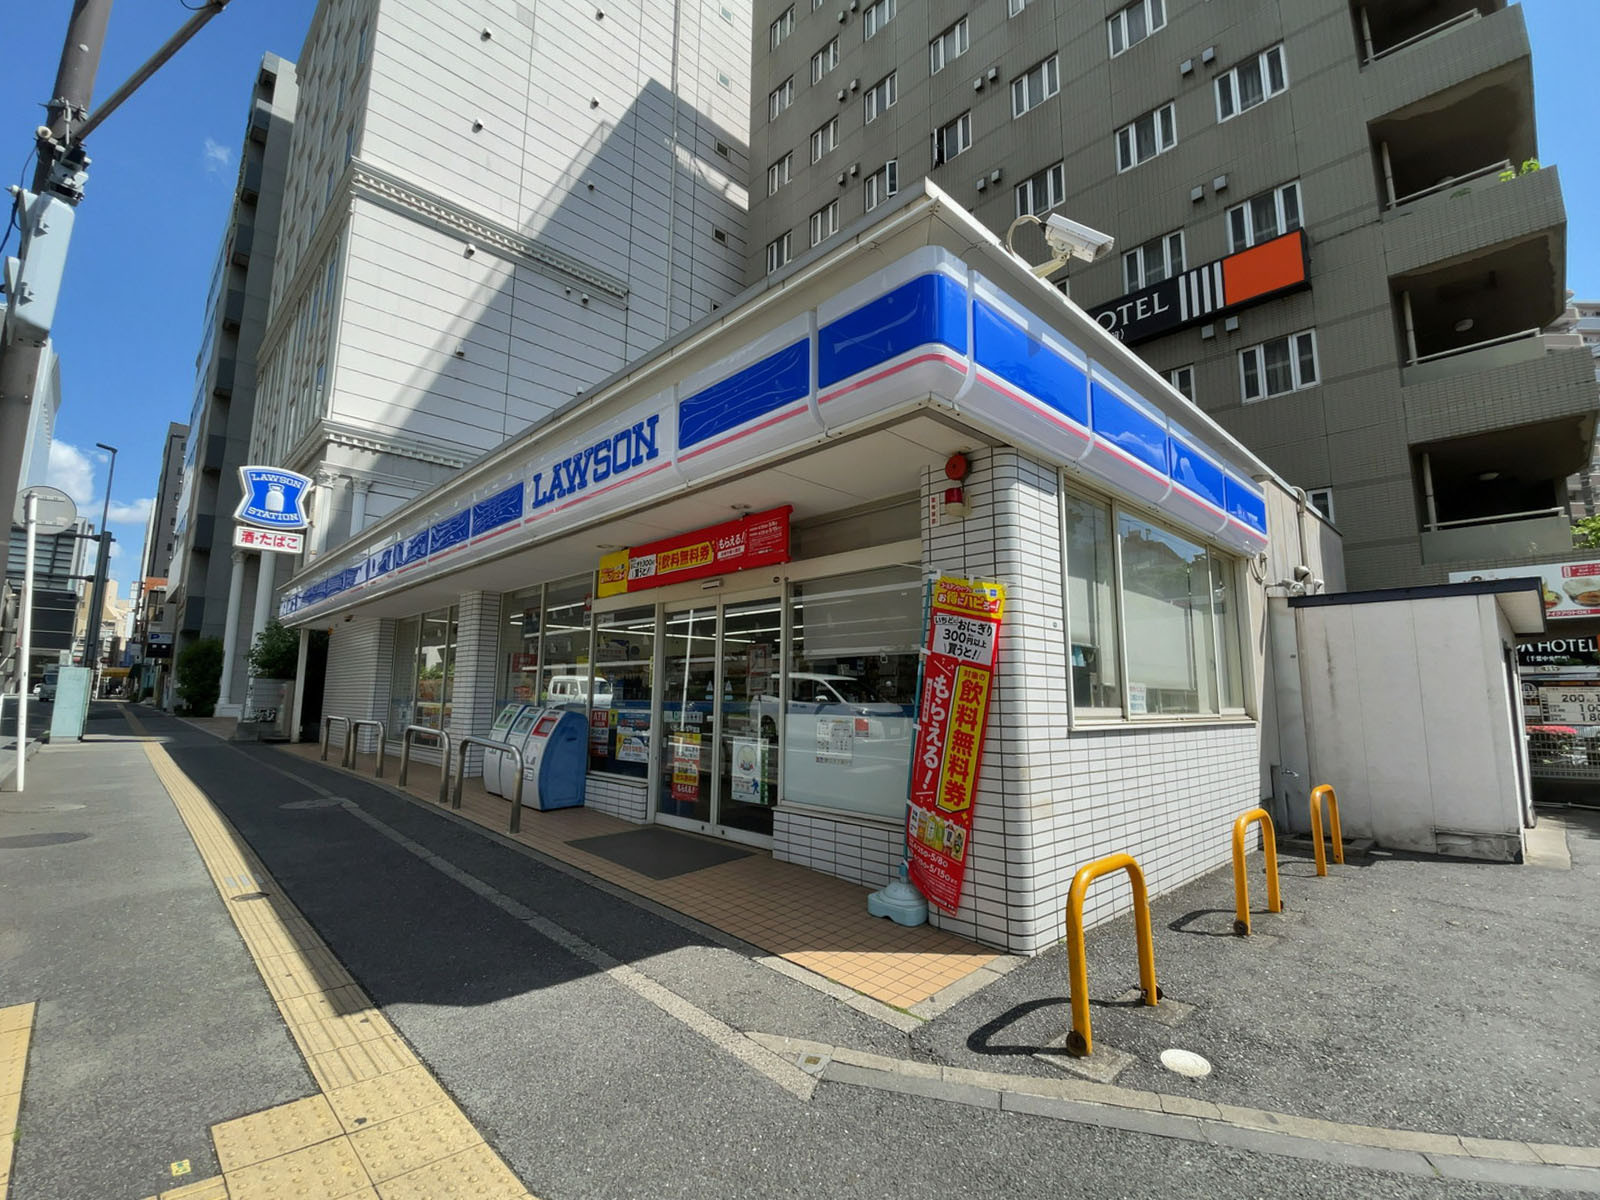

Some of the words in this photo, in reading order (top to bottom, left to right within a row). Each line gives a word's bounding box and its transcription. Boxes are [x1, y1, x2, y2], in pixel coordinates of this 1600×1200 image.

[1095, 292, 1169, 332] OTEL
[532, 414, 659, 509] LAWSON
[250, 473, 302, 489] LAWSON
[247, 506, 300, 521] STATION
[946, 642, 978, 660] 買うと!
[1537, 639, 1598, 653] HOTEL
[922, 674, 949, 790] もらえる!
[943, 679, 984, 807] 飲料無料券
